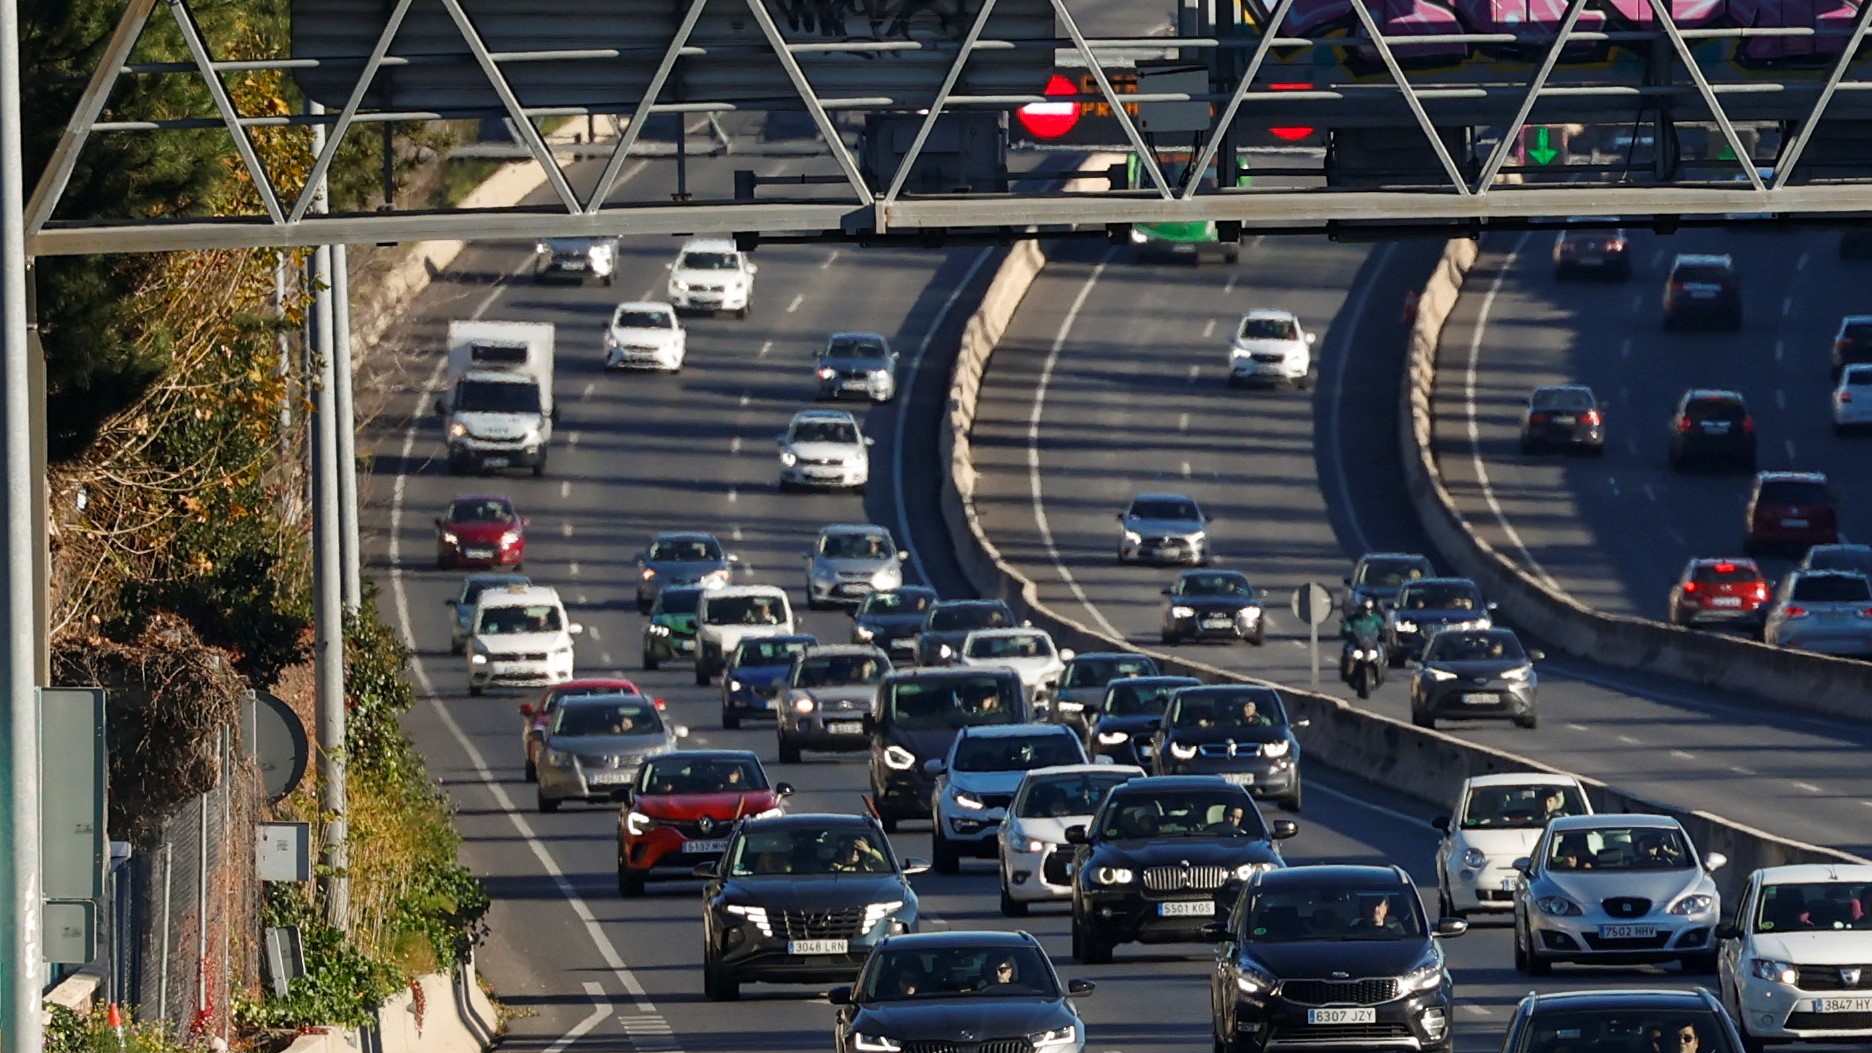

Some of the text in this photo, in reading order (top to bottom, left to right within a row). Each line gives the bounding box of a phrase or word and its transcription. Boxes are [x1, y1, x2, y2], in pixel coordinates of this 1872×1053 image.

[1164, 901, 1211, 914] 5501 KGS
[796, 941, 844, 953] 3048 LRN
[1825, 1000, 1852, 1011] 3847
[1316, 1010, 1373, 1022] 6307 JZY
